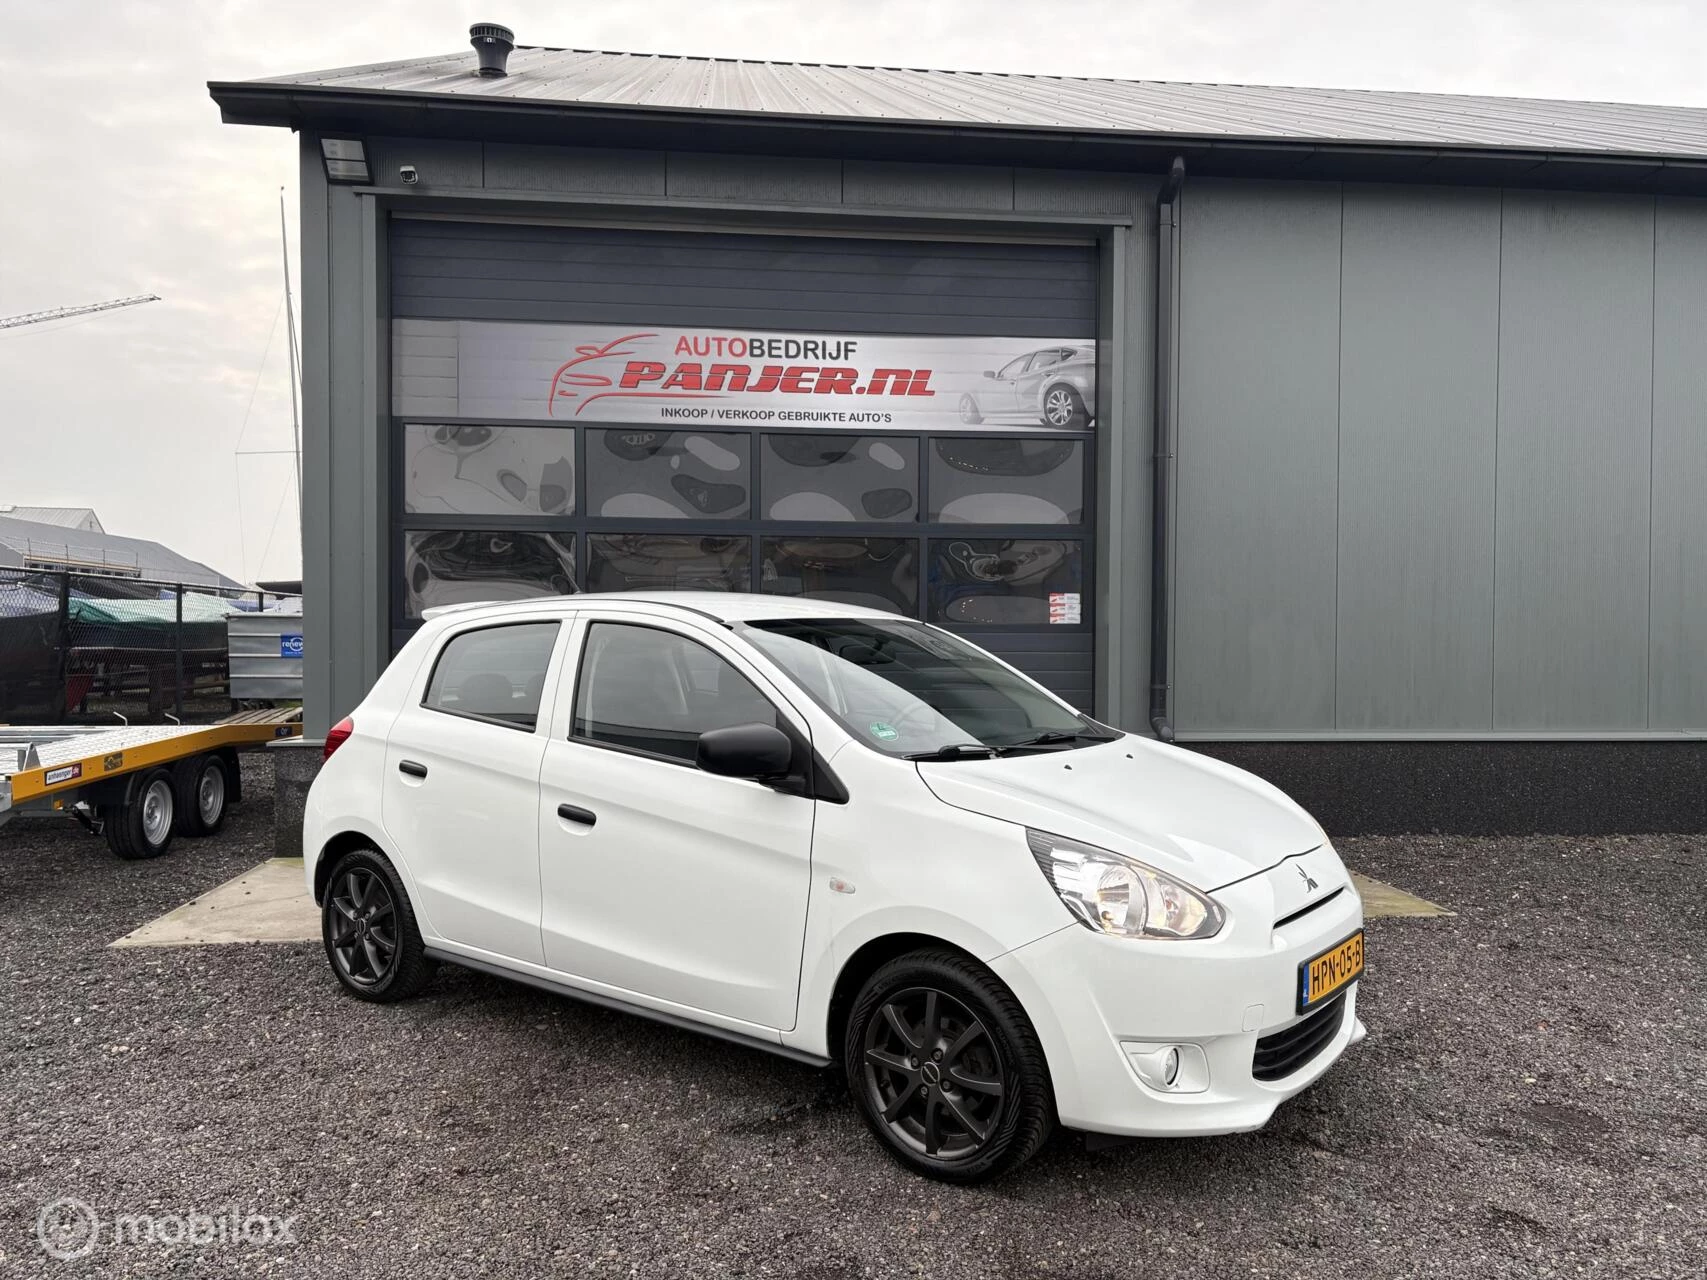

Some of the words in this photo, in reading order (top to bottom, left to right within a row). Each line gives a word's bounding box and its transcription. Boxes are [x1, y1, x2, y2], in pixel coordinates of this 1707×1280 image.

[674, 335, 858, 360] AUTOBEDRIJF
[661, 407, 708, 419] INKOOP
[710, 408, 715, 418] /
[717, 409, 775, 421] VERKOOP
[778, 411, 846, 423] GEBRUIKTE
[1312, 940, 1361, 995] HPN-05-B
